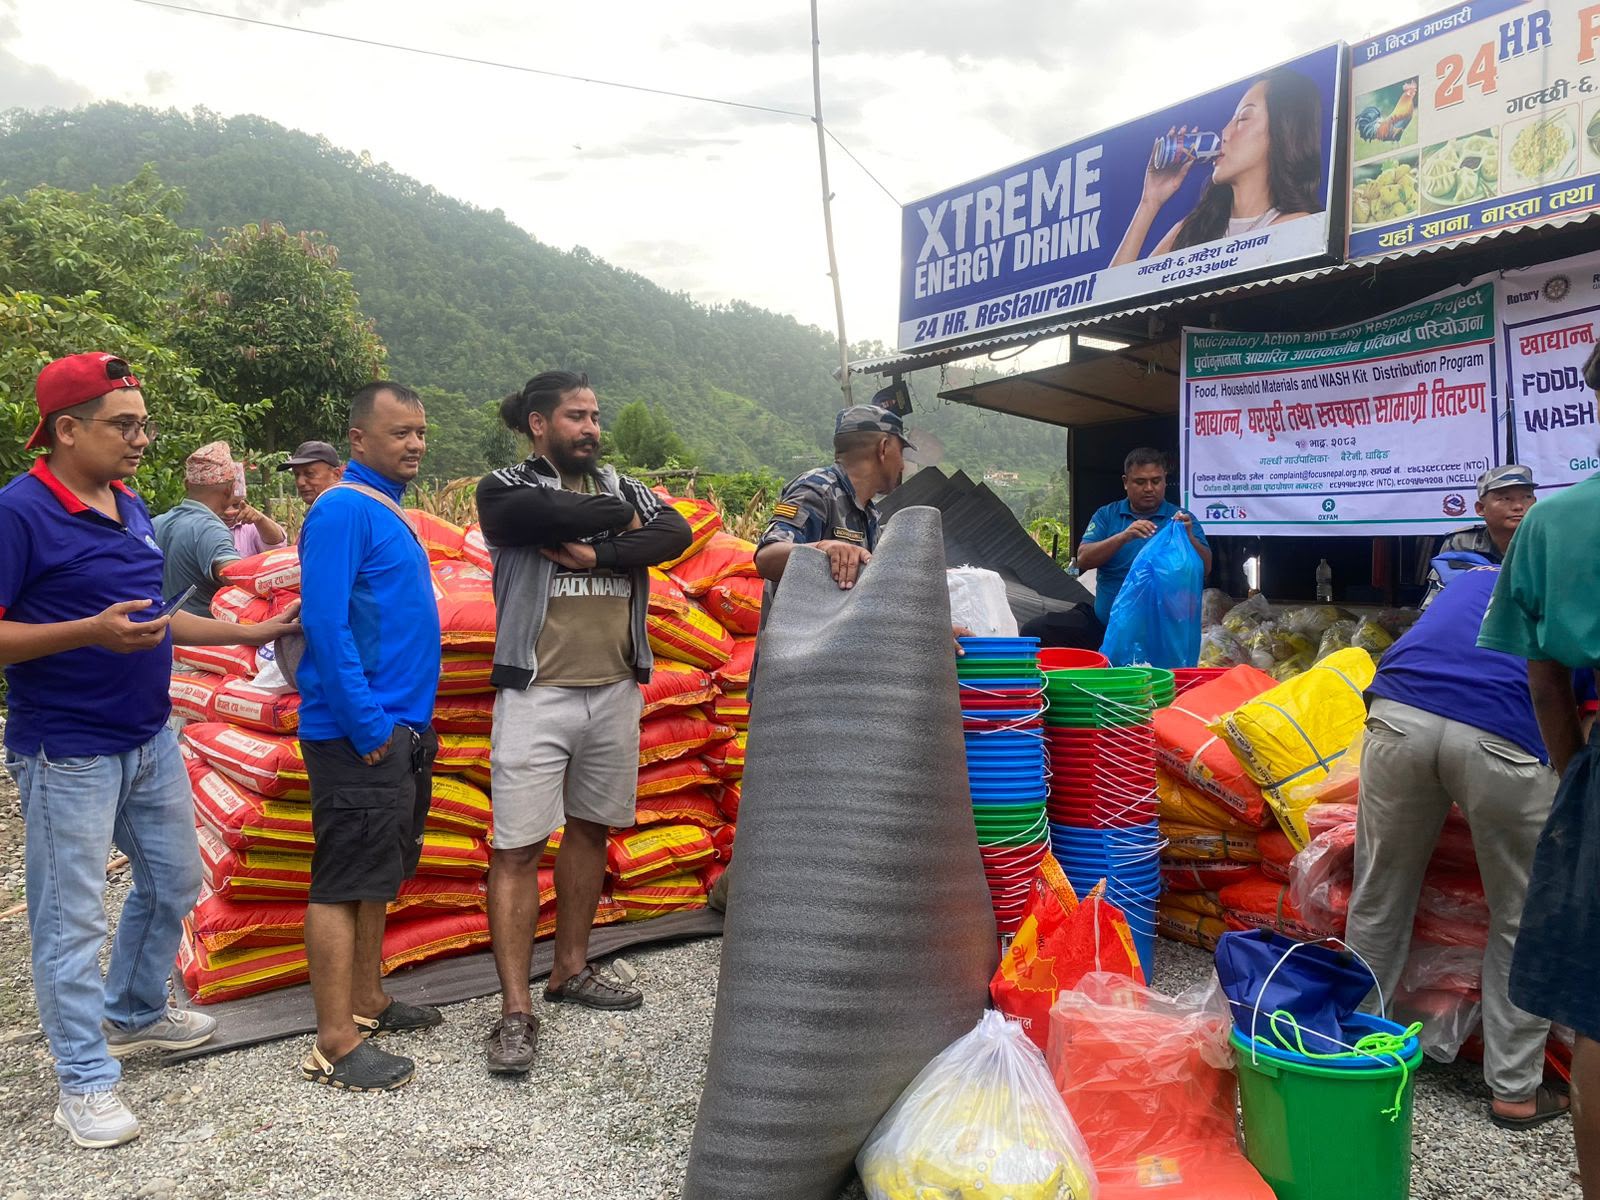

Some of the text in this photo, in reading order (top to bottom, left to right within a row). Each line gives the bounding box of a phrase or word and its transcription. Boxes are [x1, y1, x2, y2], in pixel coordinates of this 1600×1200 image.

[1366, 6, 1473, 61] प्रो. निरज भण्डारी
[1434, 40, 1498, 111] 24
[1498, 8, 1553, 63] HR
[916, 144, 1104, 264] XTREME
[1378, 222, 1414, 248] यहाँ
[1480, 196, 1543, 224] नास्ता
[1549, 183, 1596, 210] तथा
[914, 209, 1101, 300] ENERGY DRINK
[914, 316, 936, 343] 24
[975, 273, 1097, 329] Restaurant
[1193, 335, 1260, 350] Anticipatory
[1261, 332, 1300, 346] Action
[1364, 308, 1427, 334] Response
[1431, 290, 1483, 317] Project
[1507, 289, 1540, 305] Rotary
[1244, 348, 1290, 366] आधारित
[1415, 314, 1486, 341] परियोजना
[1194, 353, 1484, 399] Food, Household Materials and WASH Kit Distribution Program
[1522, 366, 1585, 397] FOOD,
[1286, 402, 1316, 431] तथा
[1431, 378, 1487, 418] वितरण
[1524, 401, 1595, 433] WASH
